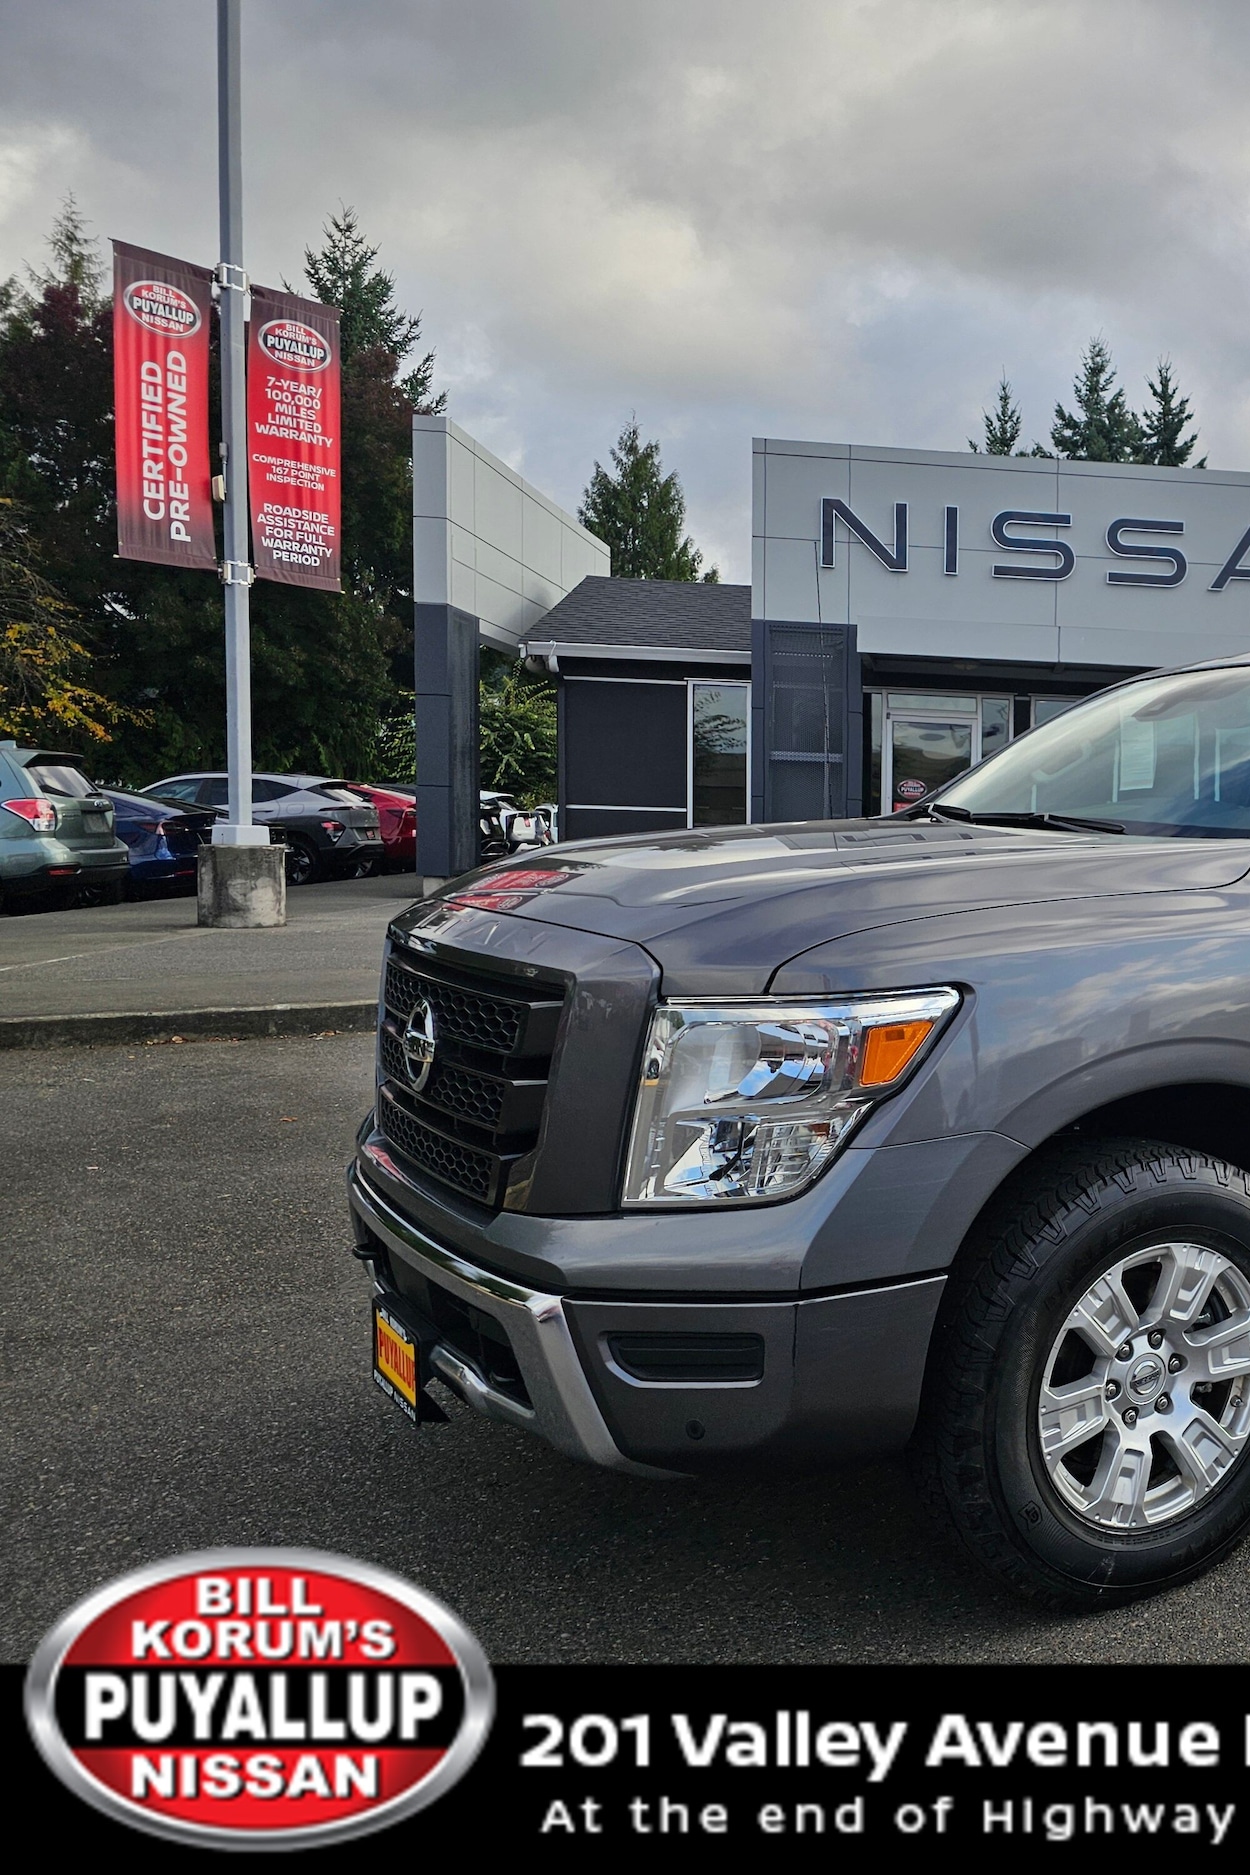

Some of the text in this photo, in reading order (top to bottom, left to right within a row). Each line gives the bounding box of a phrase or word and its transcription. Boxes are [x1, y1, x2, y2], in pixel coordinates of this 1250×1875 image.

[141, 289, 187, 309] KORUM'S
[152, 285, 175, 298] BILL
[132, 296, 194, 325] PUYALLUP
[141, 312, 184, 333] NISSAN
[285, 324, 306, 336] BILL
[266, 335, 325, 360] PUYALLUP
[275, 328, 317, 345] KORUM'S
[274, 350, 315, 367] NISSAN
[266, 375, 323, 399] 7-YEAR/
[265, 388, 321, 410] 100,000
[275, 402, 316, 421] MILES
[267, 412, 322, 434] LIMITED
[140, 360, 166, 521] CERTIFIED
[254, 421, 333, 448] WARRANTY
[166, 350, 192, 543] PRE-OWNED
[252, 453, 336, 477] COMPREHENSIVE
[271, 465, 321, 481] 167 POINT
[266, 472, 325, 491] INSPECTION
[263, 502, 329, 524] ROADSIDE
[257, 513, 335, 537] ASSISTANCE
[265, 525, 326, 546] FOR FULL
[261, 536, 333, 558] WARRANTY
[272, 549, 321, 567] PERIOD
